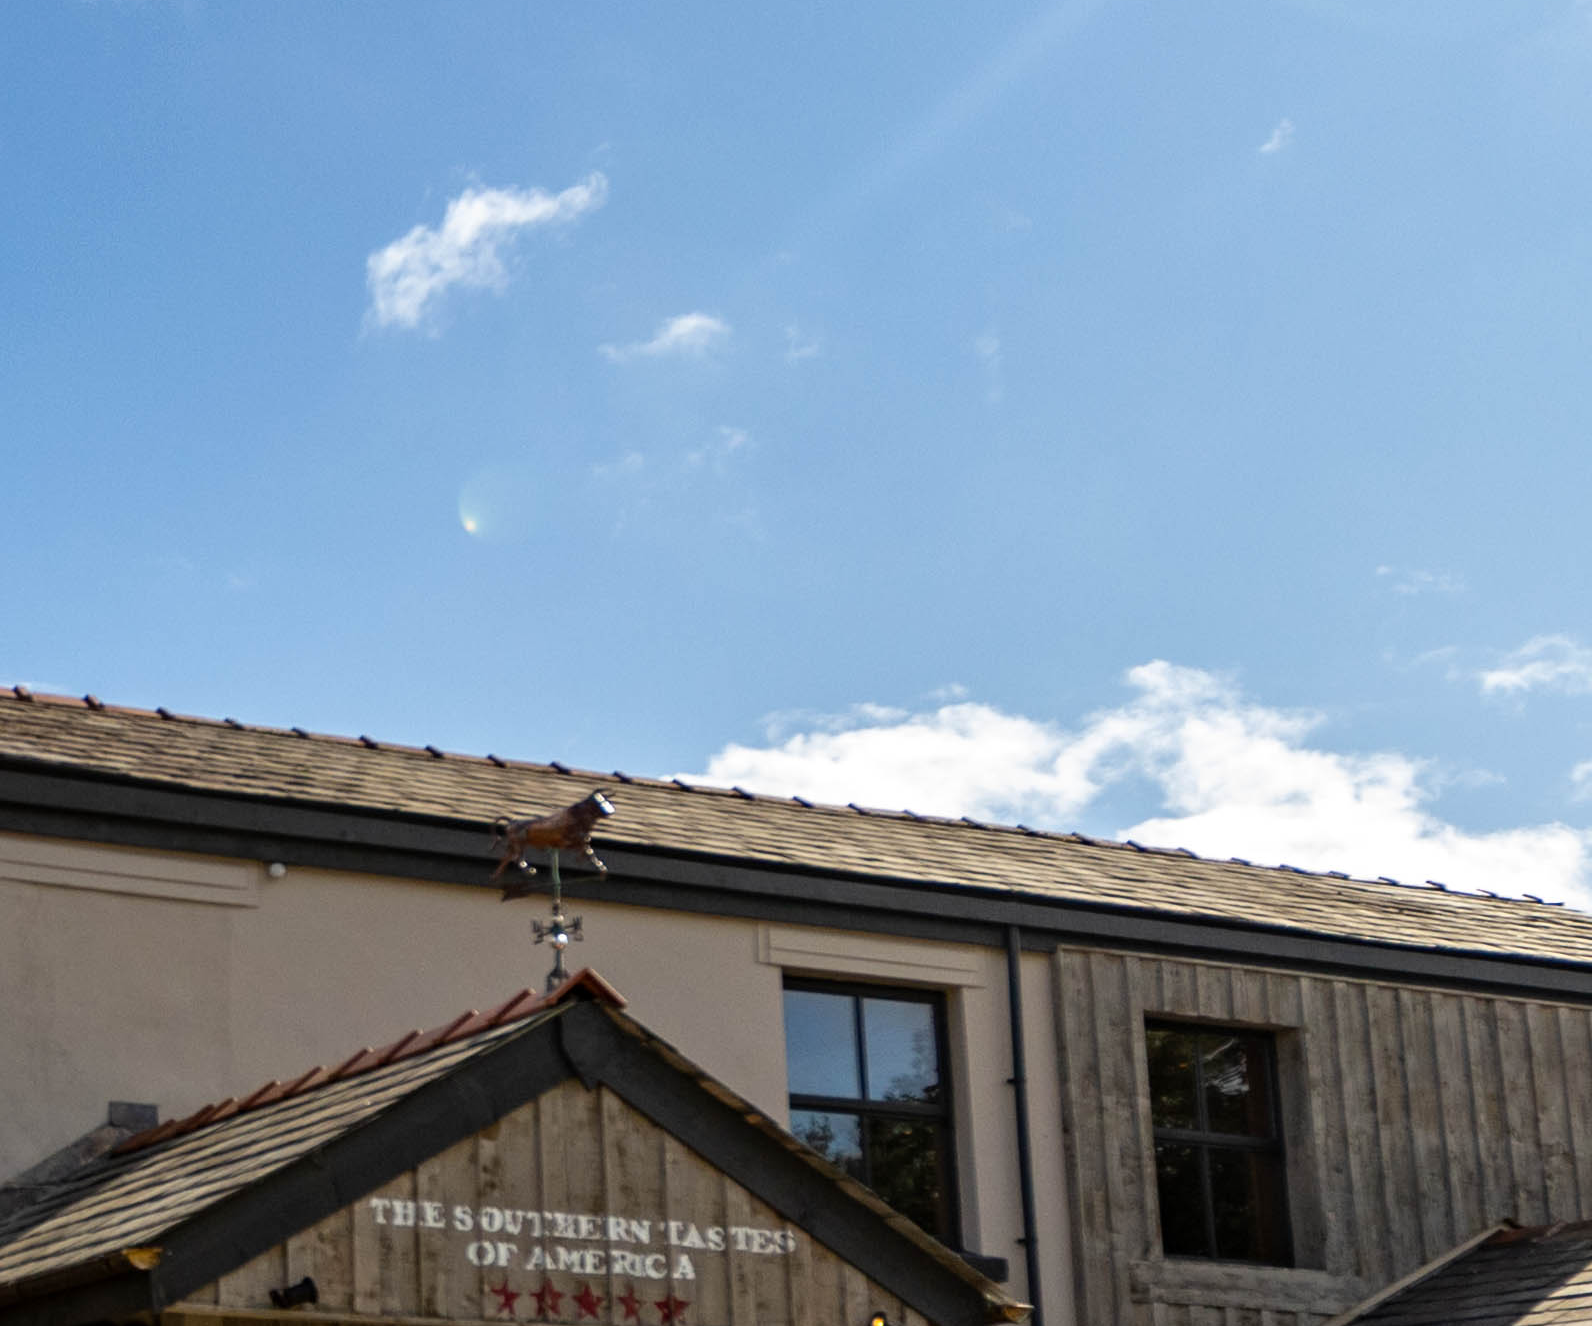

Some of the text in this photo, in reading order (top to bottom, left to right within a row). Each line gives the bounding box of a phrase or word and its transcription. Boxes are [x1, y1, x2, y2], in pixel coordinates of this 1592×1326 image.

[370, 1198, 796, 1255] THE SOUTHERN TASTES
[466, 1241, 697, 1281] OF AMERICA
